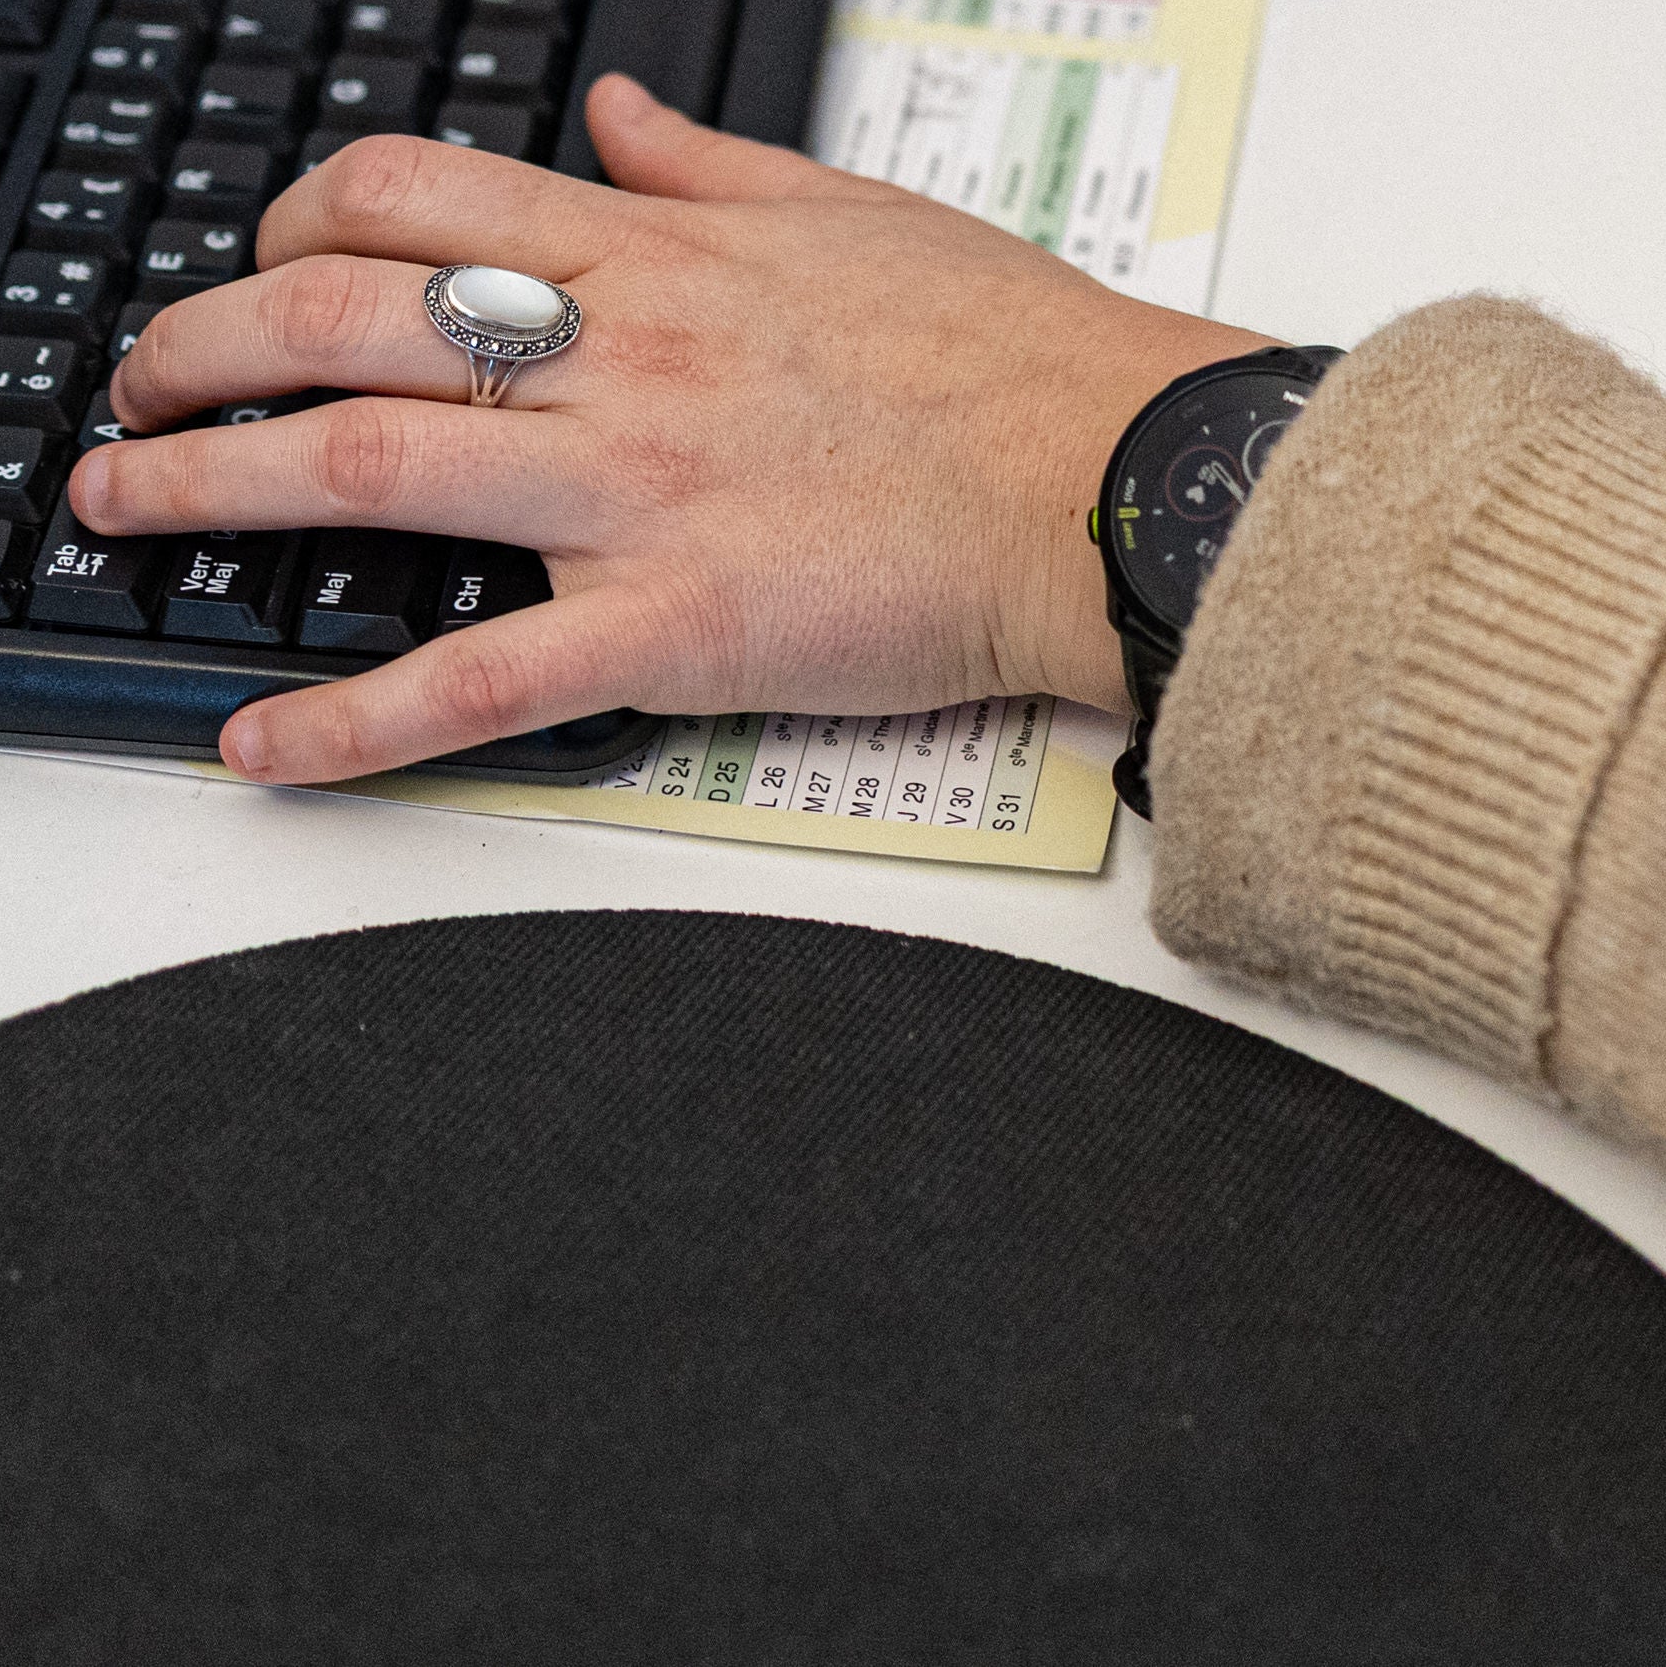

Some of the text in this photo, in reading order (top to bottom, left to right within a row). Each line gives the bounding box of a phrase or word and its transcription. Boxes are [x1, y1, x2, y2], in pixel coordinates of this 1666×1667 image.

[199, 89, 237, 112] T
[64, 122, 101, 142] 5
[174, 167, 214, 191] R
[37, 202, 72, 220] 4
[146, 250, 184, 271] E
[5, 285, 40, 303] 3
[93, 423, 124, 440] A
[46, 544, 79, 577] Tab
[180, 552, 214, 592] Verr
[205, 562, 242, 595] Maj
[317, 571, 353, 605] Maj
[453, 576, 485, 612] Ctrl
[919, 709, 942, 744] Gildas
[968, 702, 990, 743] Martine
[1015, 702, 1039, 748] Marcelle
[667, 756, 693, 779] 24
[714, 761, 740, 784] 25
[761, 766, 787, 789] 26
[614, 775, 637, 789] V
[662, 784, 684, 797] S
[808, 771, 833, 794] 27
[854, 777, 880, 800] 28
[902, 782, 927, 805] 29
[707, 789, 730, 802] D
[755, 797, 778, 808] L
[802, 797, 827, 813] M
[949, 786, 975, 809] 30
[997, 793, 1023, 813] 31
[848, 801, 874, 818] M
[897, 811, 920, 822] J
[944, 812, 969, 826] V
[992, 817, 1016, 832] S
